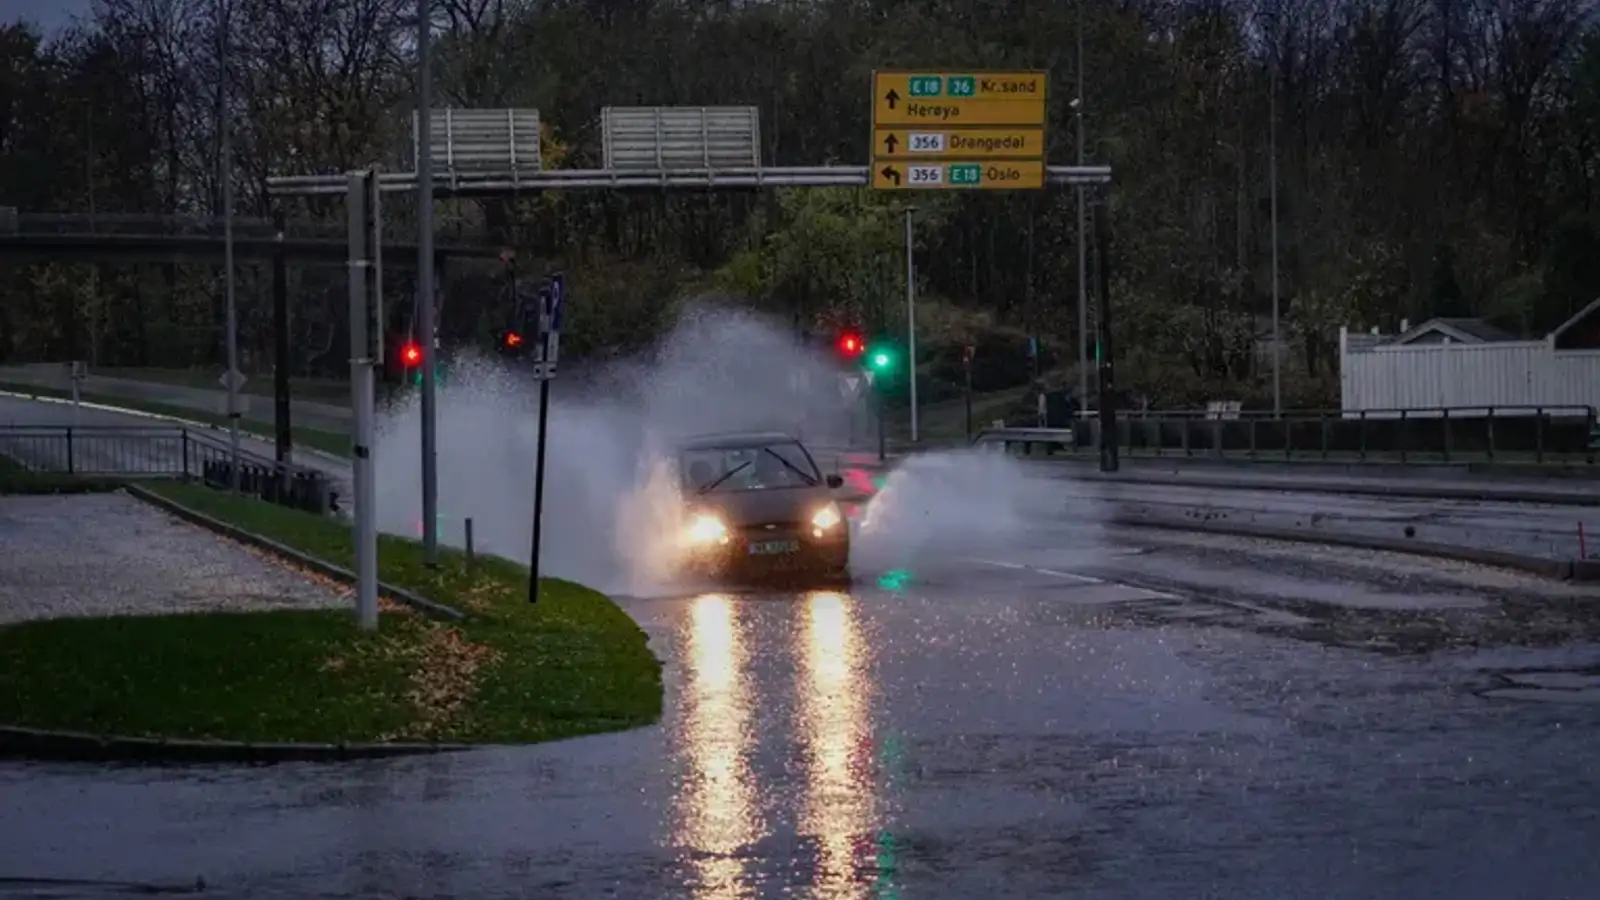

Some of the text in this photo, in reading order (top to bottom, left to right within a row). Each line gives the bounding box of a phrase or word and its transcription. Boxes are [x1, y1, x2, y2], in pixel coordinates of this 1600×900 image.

[981, 79, 1036, 93] Kr.sand
[914, 135, 1025, 152] 356 Drangedal
[913, 169, 939, 181] 356
[987, 166, 1020, 181] Oslo
